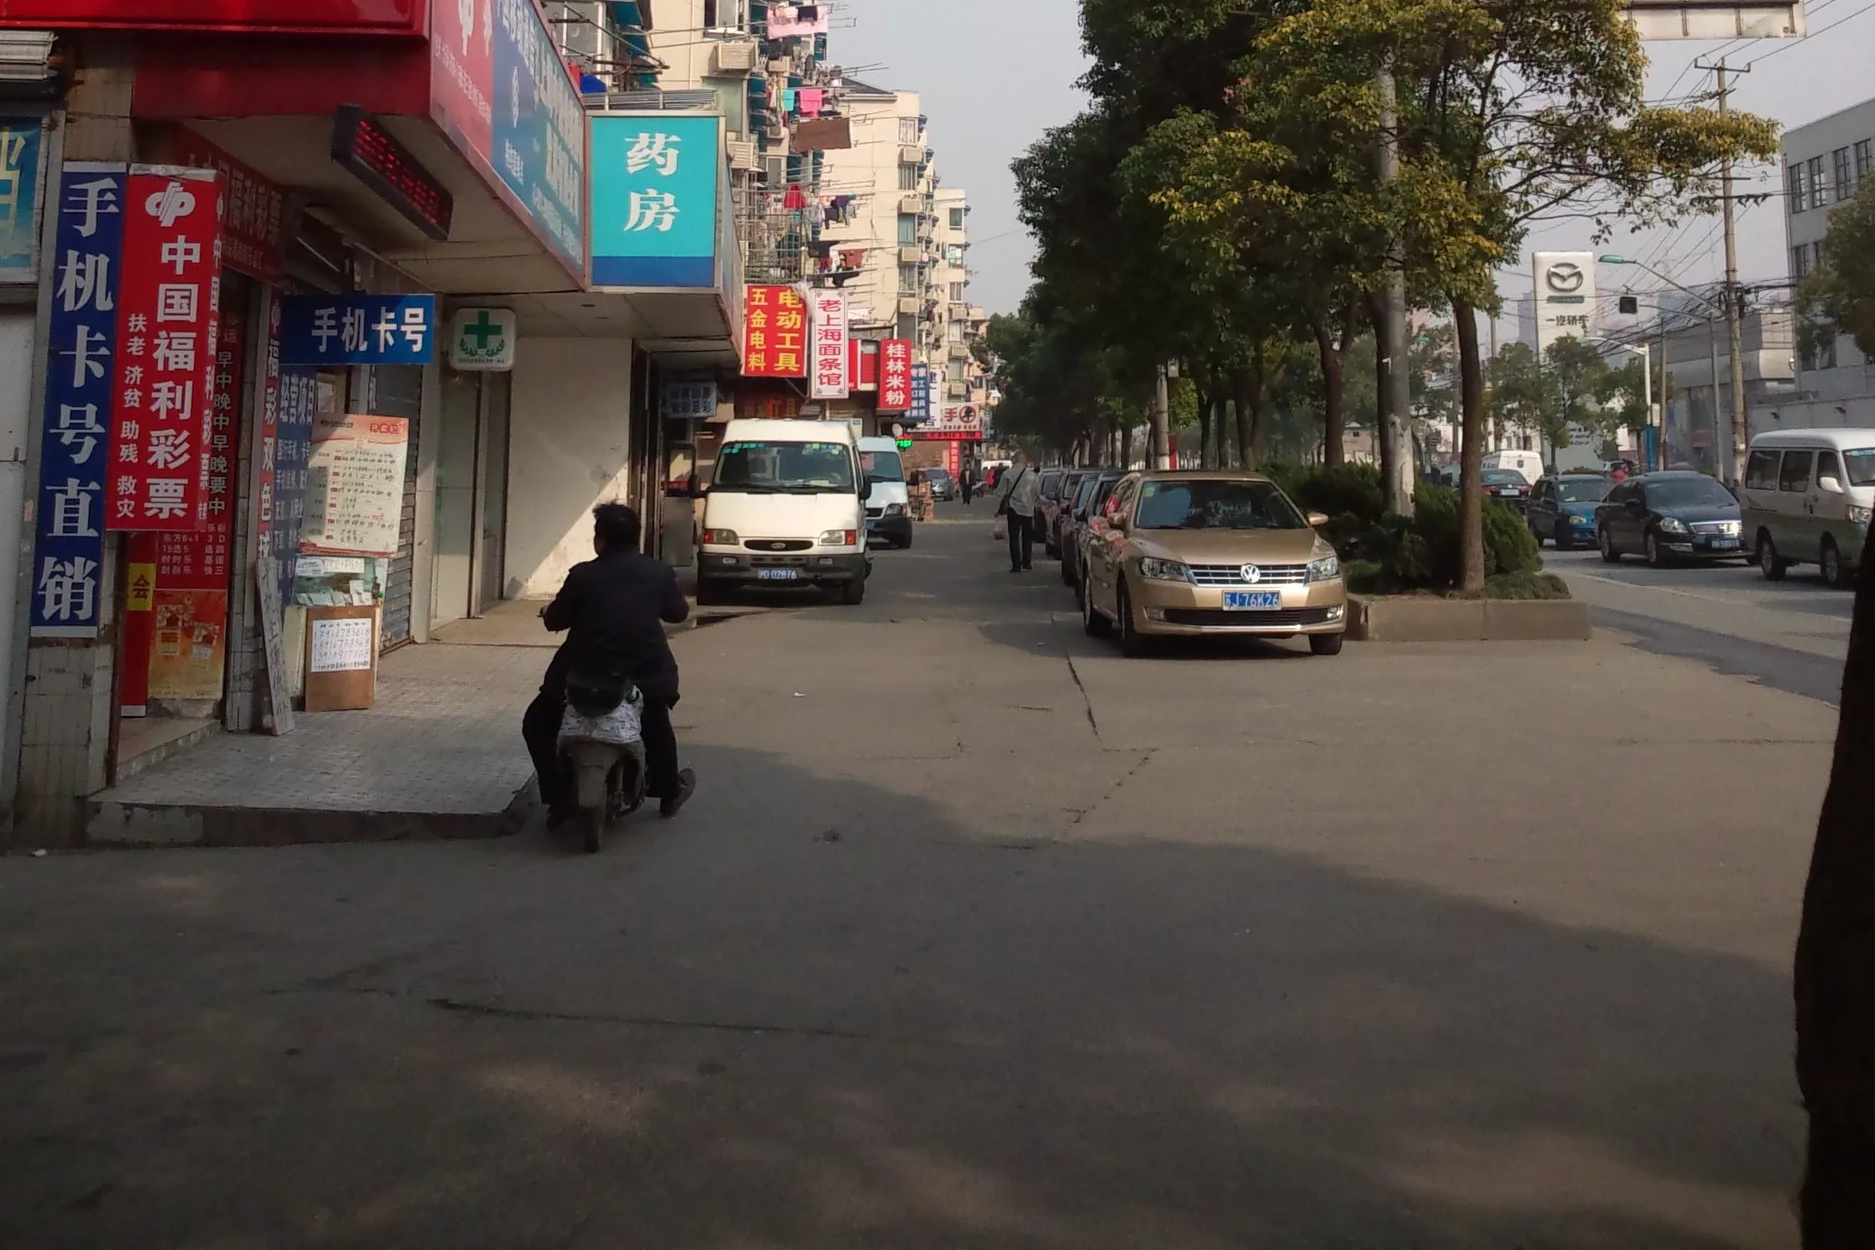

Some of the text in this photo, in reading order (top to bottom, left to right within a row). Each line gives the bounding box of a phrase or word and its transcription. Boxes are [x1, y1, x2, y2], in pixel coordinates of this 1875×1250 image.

[624, 132, 681, 232] 药房
[312, 306, 427, 353] 手机卡号
[748, 288, 768, 371] 五金电料
[774, 289, 803, 371] 电动工具
[818, 299, 842, 385] 老上海面条馆
[37, 178, 119, 622] 手机卡号直销
[116, 313, 147, 519] 扶老 济贫 助残 救灾
[144, 235, 201, 519] 中国福利彩票
[886, 343, 906, 405] 桂林米粉
